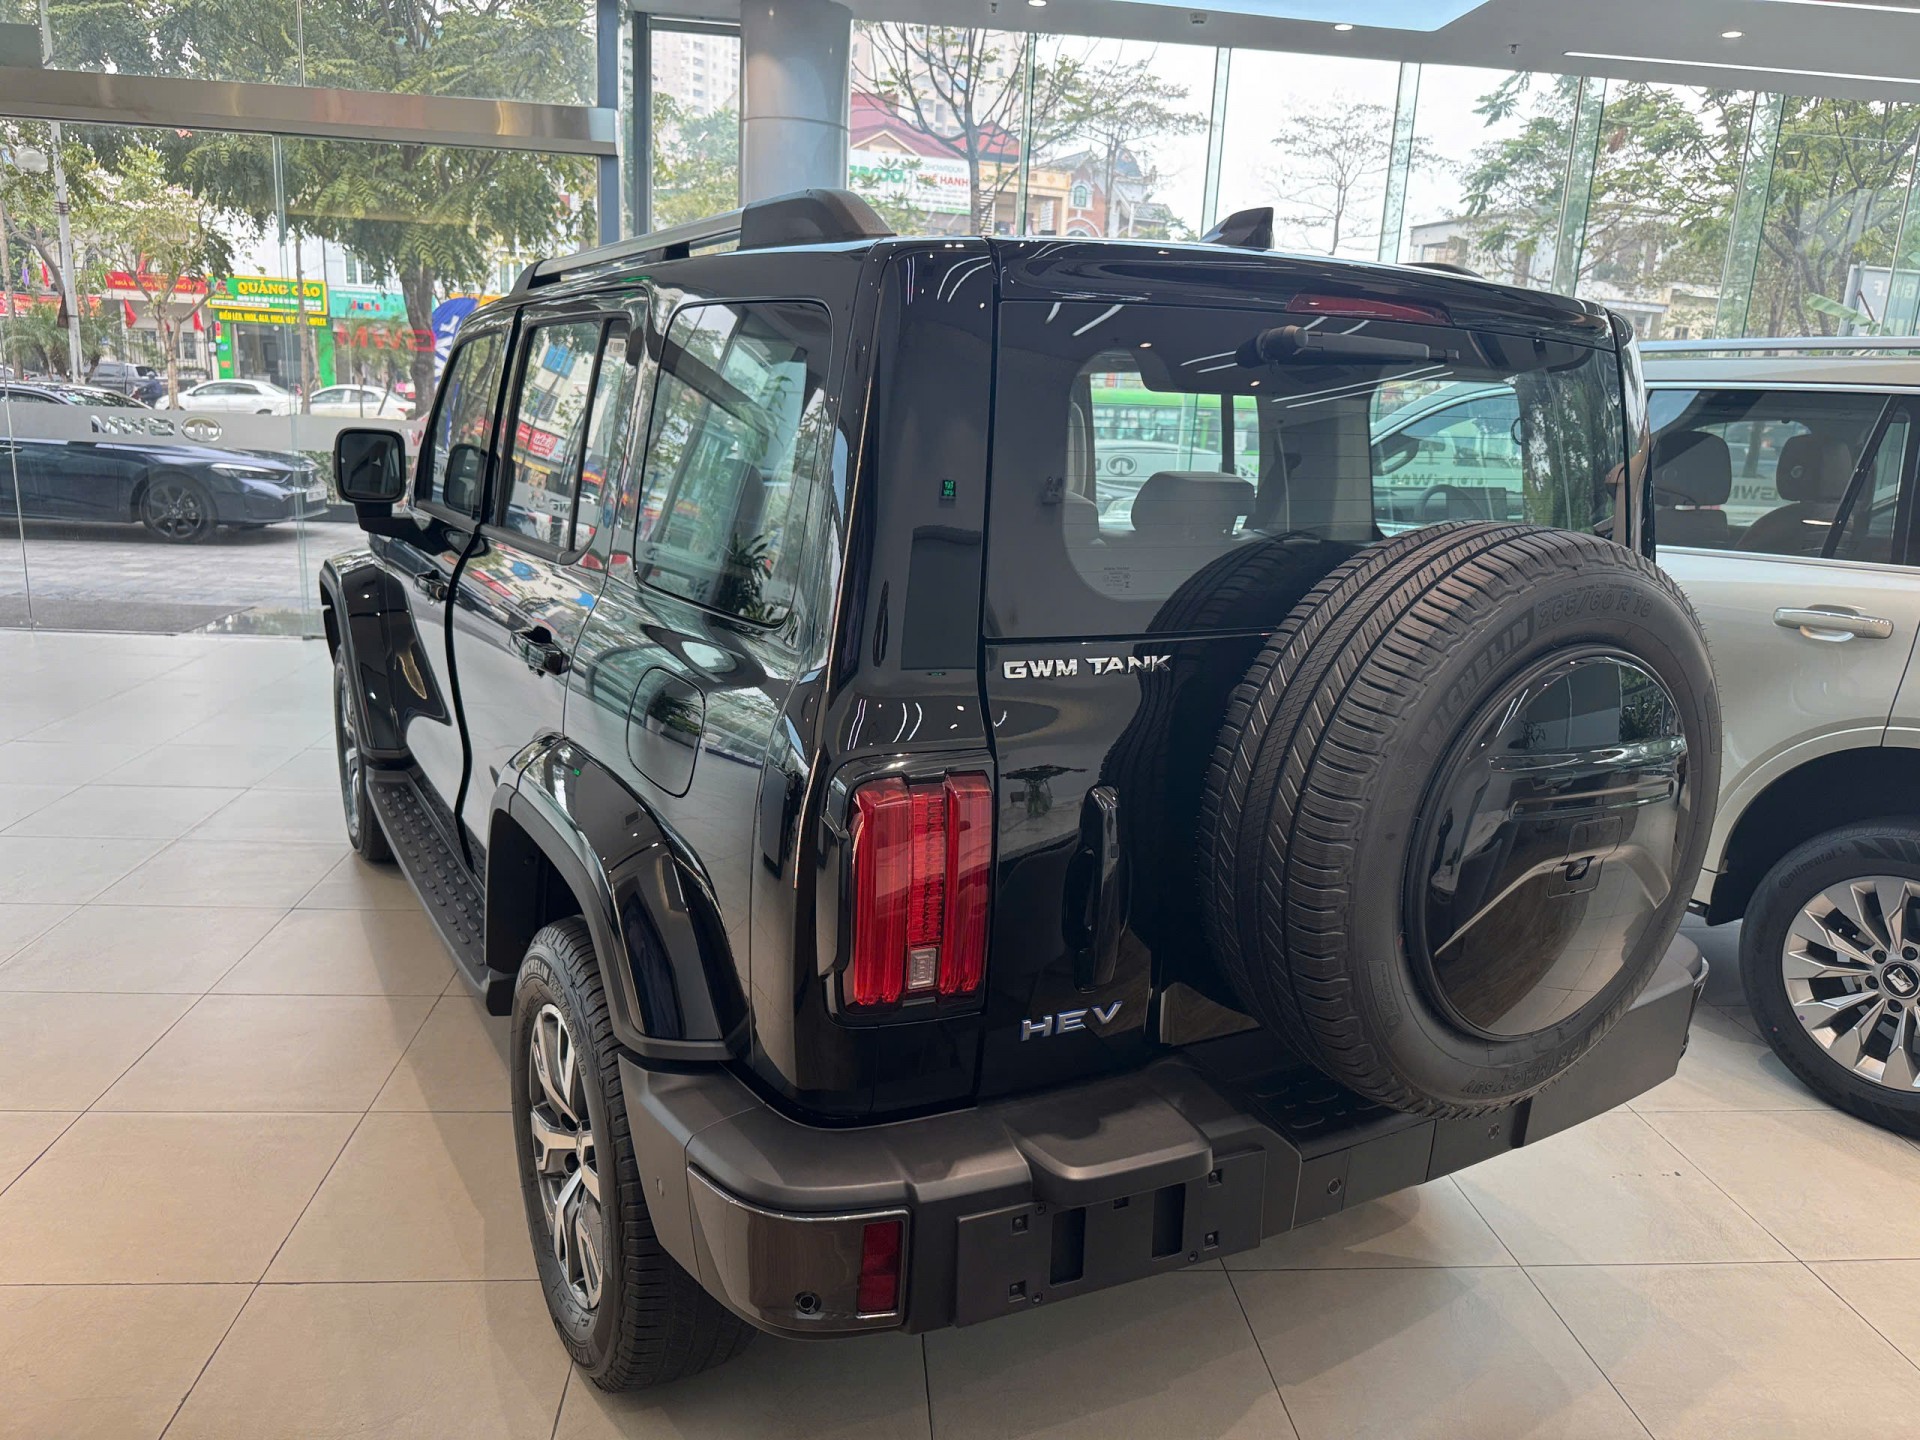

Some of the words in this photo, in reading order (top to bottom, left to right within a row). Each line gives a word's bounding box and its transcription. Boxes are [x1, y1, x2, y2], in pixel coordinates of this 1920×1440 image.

[238, 280, 290, 295] QUẢNG
[1003, 658, 1078, 680] GWM
[1085, 654, 1172, 676] TANK
[1418, 616, 1532, 752] MICHELIN
[521, 957, 550, 983] MICHELIN
[1020, 1000, 1124, 1042] HEV
